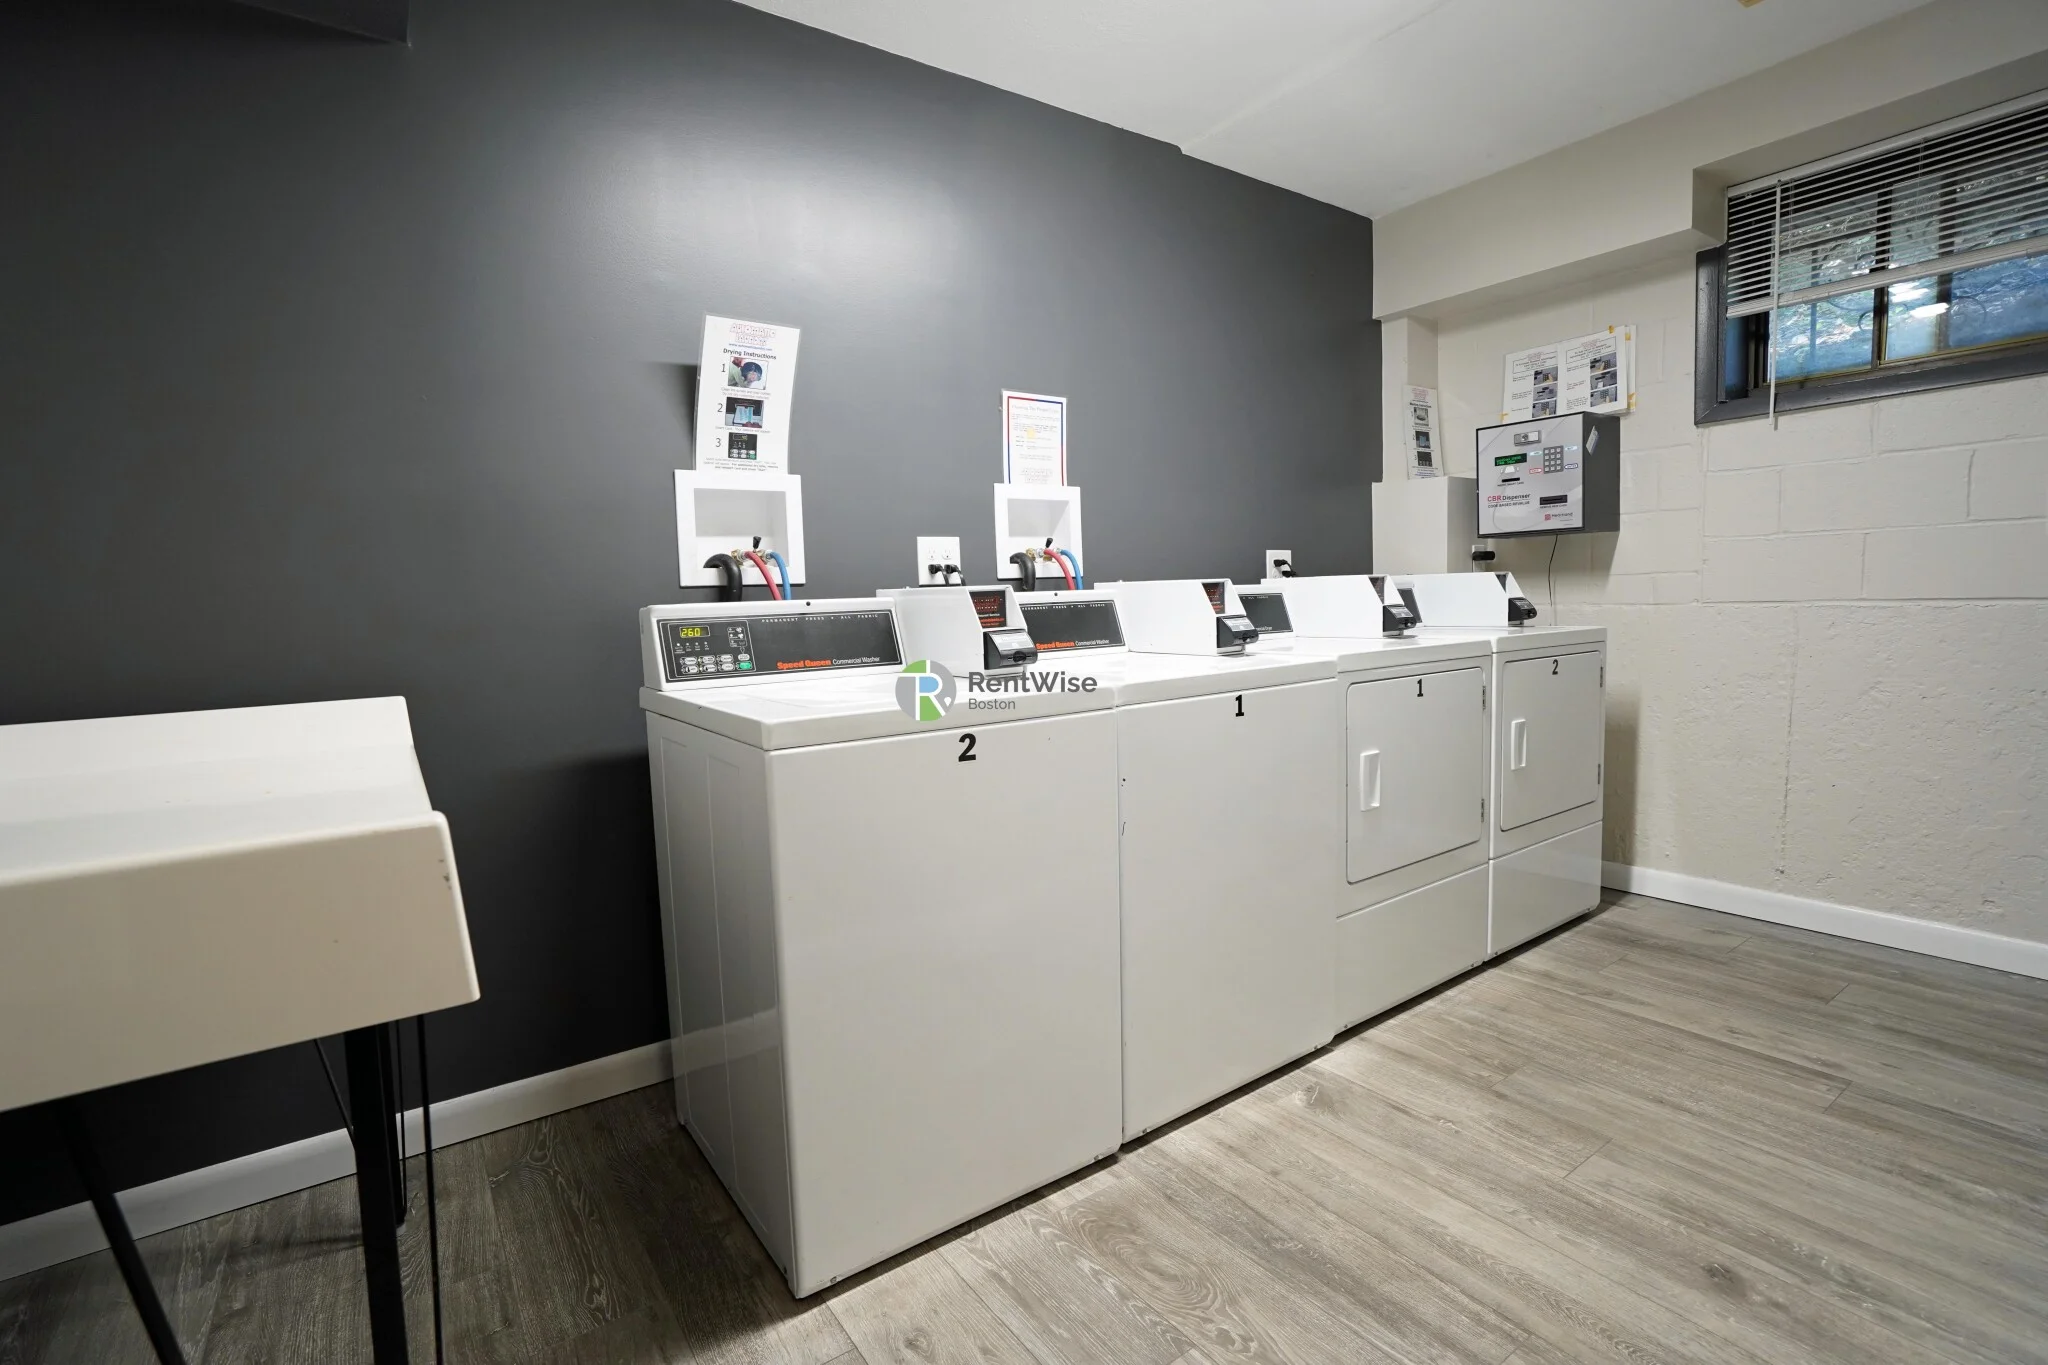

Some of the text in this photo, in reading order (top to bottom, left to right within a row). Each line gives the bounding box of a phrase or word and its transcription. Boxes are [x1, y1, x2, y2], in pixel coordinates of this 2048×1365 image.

[723, 347, 777, 360] Drying Instructions
[721, 363, 726, 372] 1
[717, 403, 723, 412] 2
[715, 437, 721, 447] 3
[1502, 493, 1531, 501] Dispenser
[681, 628, 701, 637] 260
[1035, 642, 1055, 650] Speed
[776, 660, 805, 670] Speed
[805, 659, 832, 668] Queen
[832, 657, 861, 666] Commercial
[1552, 659, 1559, 675] 2
[1416, 678, 1424, 698] 1
[1235, 694, 1245, 717] 1
[958, 733, 977, 762] 2
